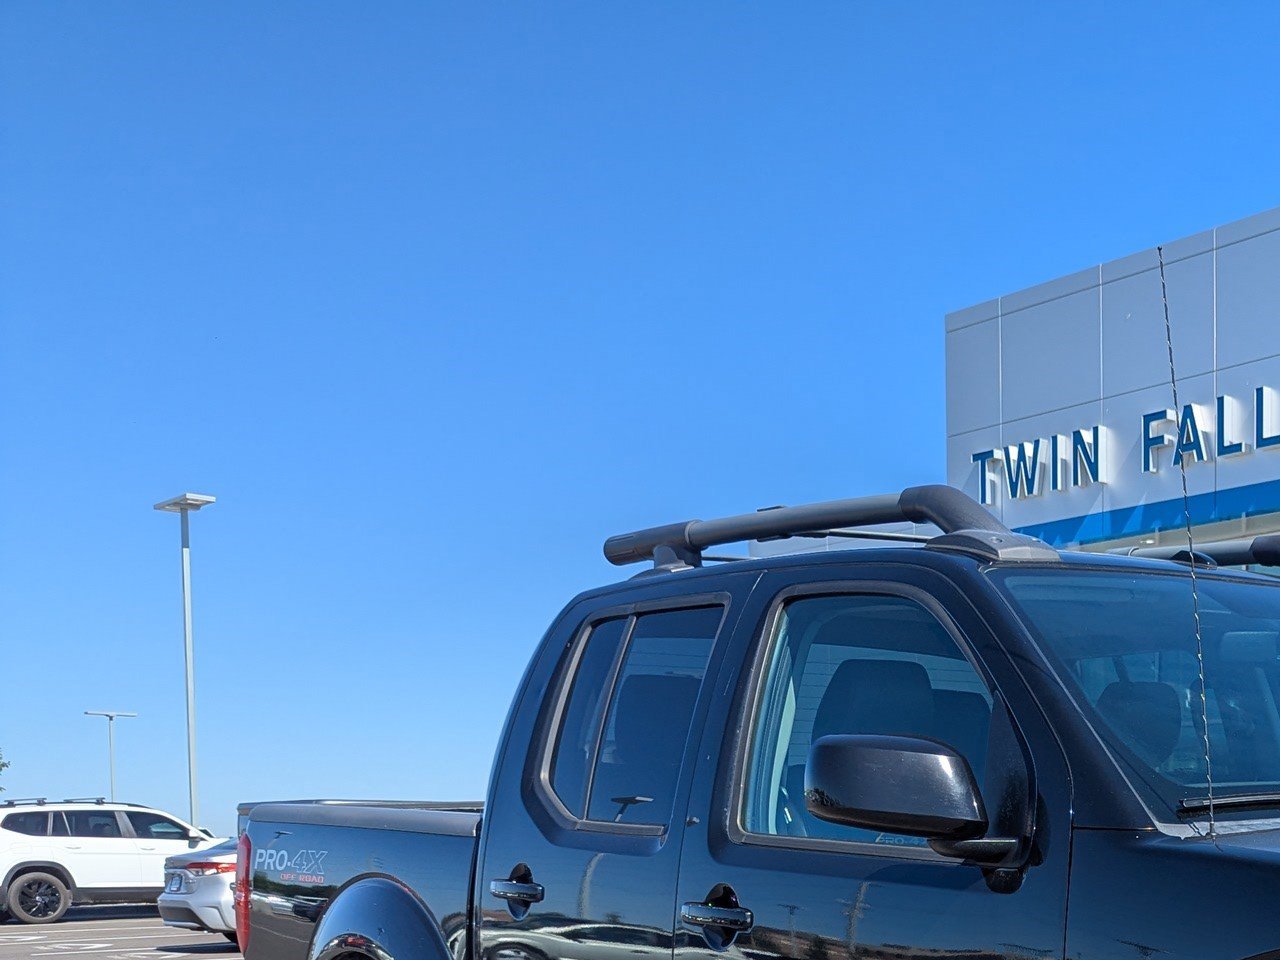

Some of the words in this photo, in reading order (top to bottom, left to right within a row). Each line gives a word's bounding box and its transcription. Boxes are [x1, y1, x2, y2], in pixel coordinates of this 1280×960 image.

[971, 426, 1105, 504] TWIN
[280, 873, 297, 882] OFF
[299, 874, 325, 884] ROAD
